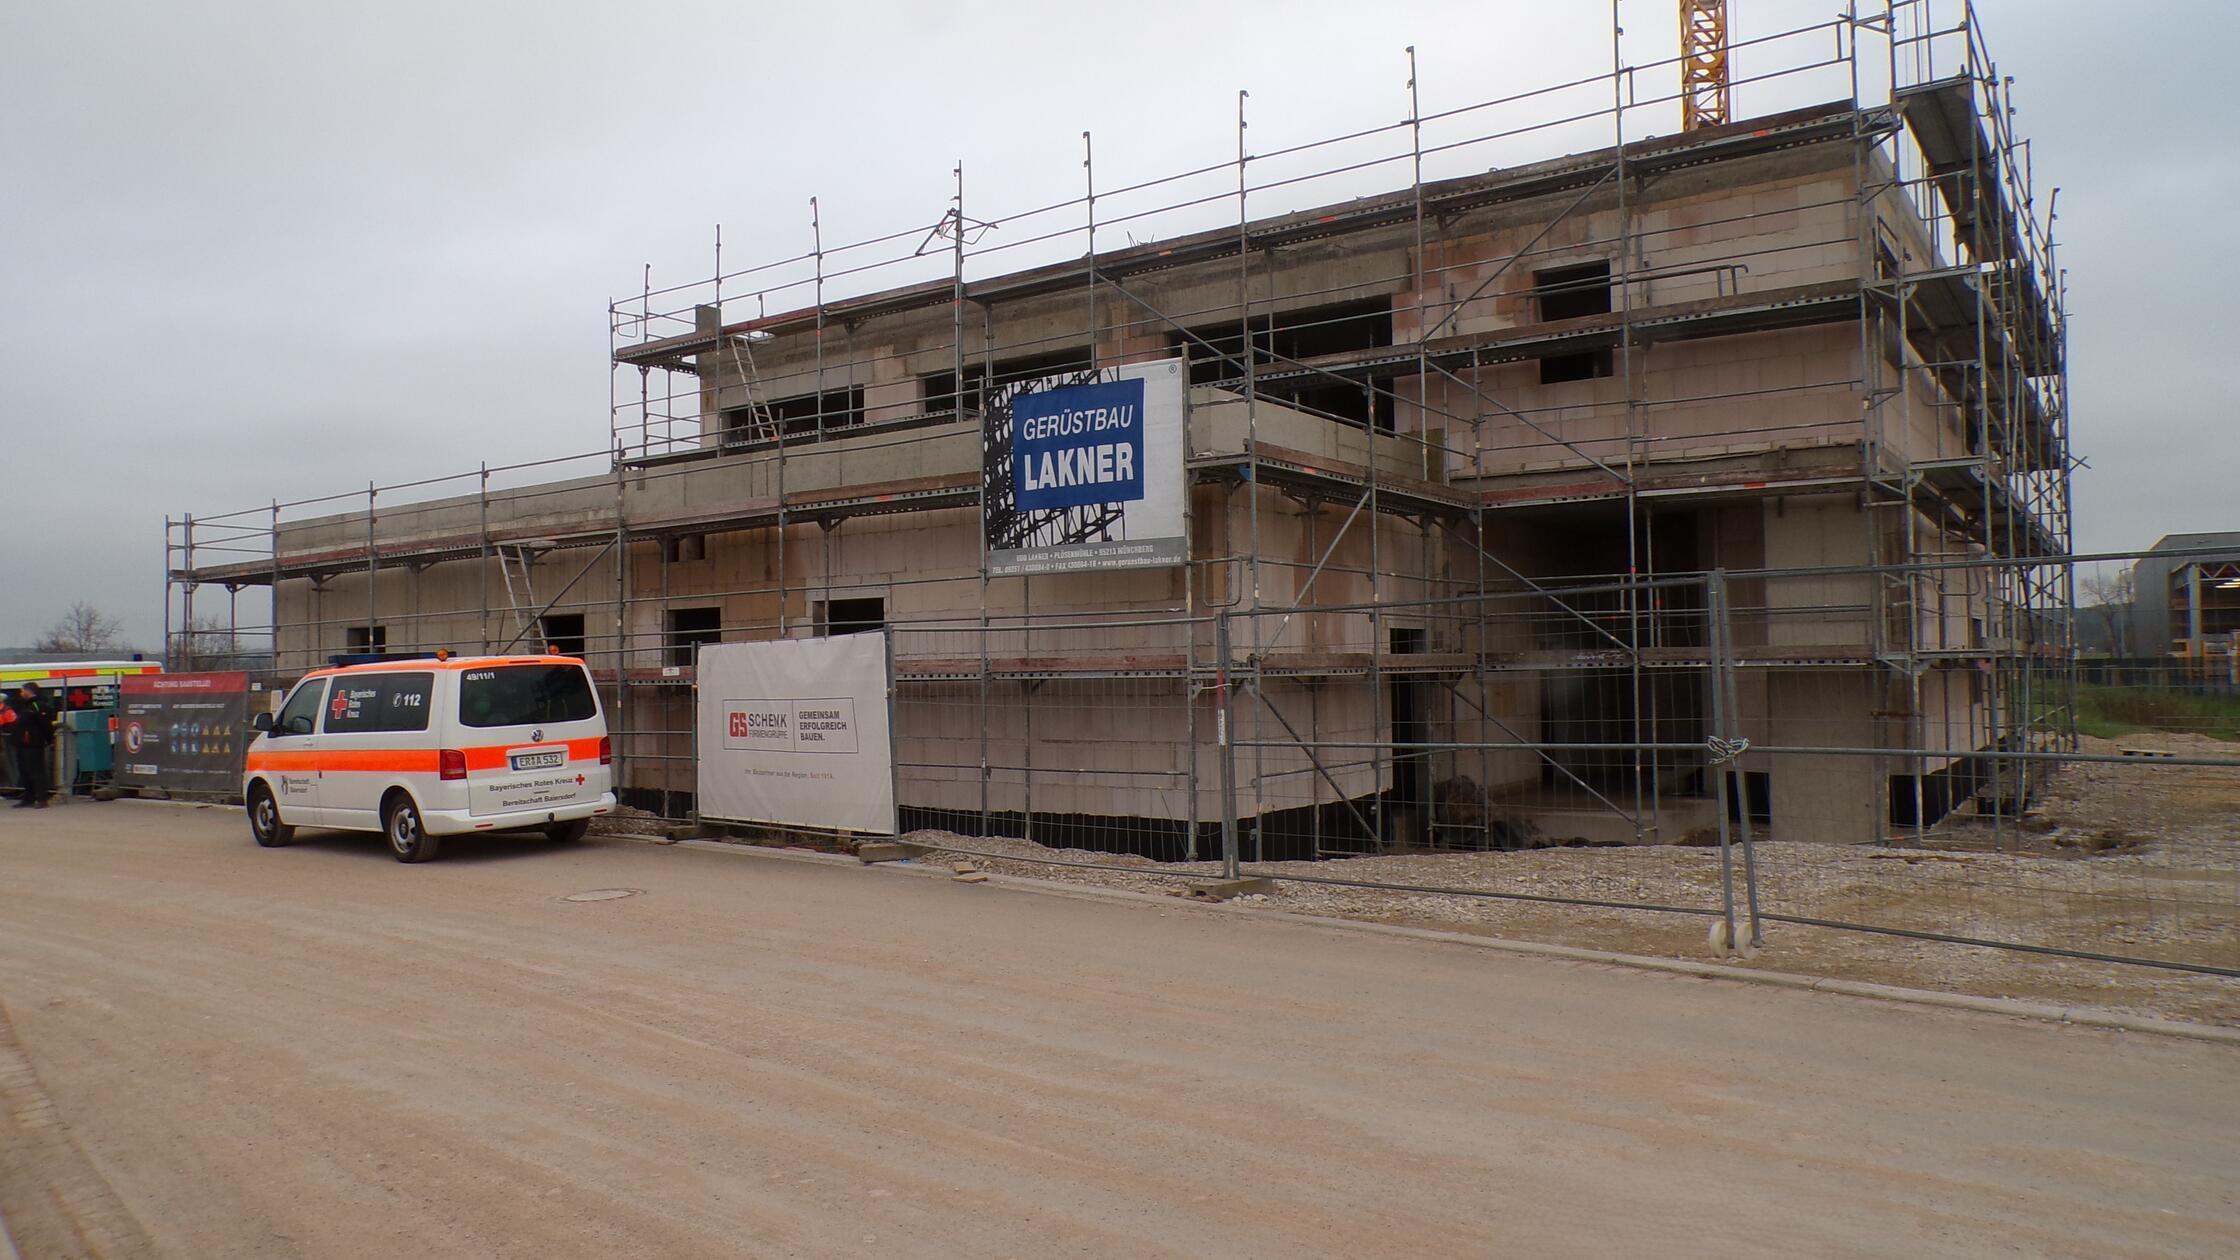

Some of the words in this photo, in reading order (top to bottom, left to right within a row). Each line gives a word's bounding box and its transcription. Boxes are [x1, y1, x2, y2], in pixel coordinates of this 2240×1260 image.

[1023, 404, 1134, 441] GERÜSTBAU
[1024, 442, 1134, 491] LAKNER
[466, 671, 495, 681] 49/11/1
[403, 693, 421, 707] 112
[798, 710, 840, 720] GEMEINSAM
[729, 712, 748, 737] GS
[748, 713, 787, 728] SCHENK
[799, 721, 847, 731] ERFOLGREICH
[800, 732, 825, 741] BAUEN.
[543, 754, 558, 764] 532
[489, 781, 532, 792] Bayerisches
[502, 797, 543, 807] Bereitschaft
[544, 792, 576, 802] Baiersdorf
